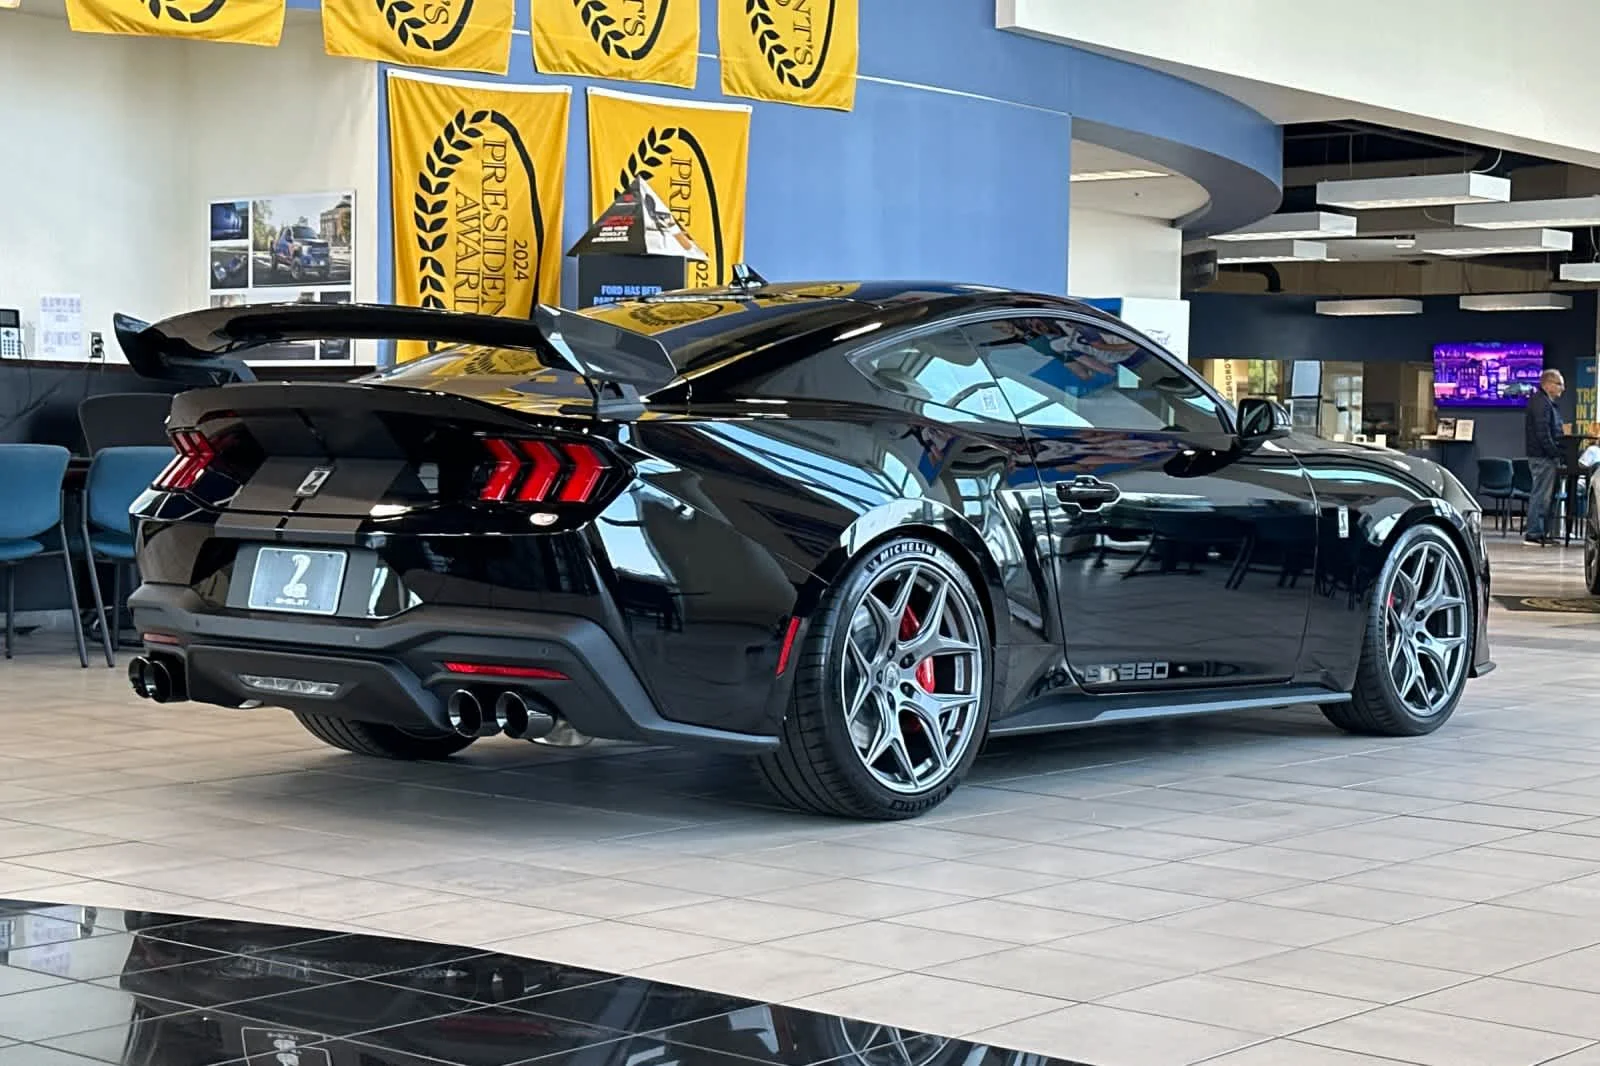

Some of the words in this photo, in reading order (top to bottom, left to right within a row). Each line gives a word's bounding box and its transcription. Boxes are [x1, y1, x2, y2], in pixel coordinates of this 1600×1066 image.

[513, 239, 529, 281] 2024
[601, 285, 623, 296] FORD
[624, 285, 640, 296] HAS
[880, 541, 935, 560] MICHELIN
